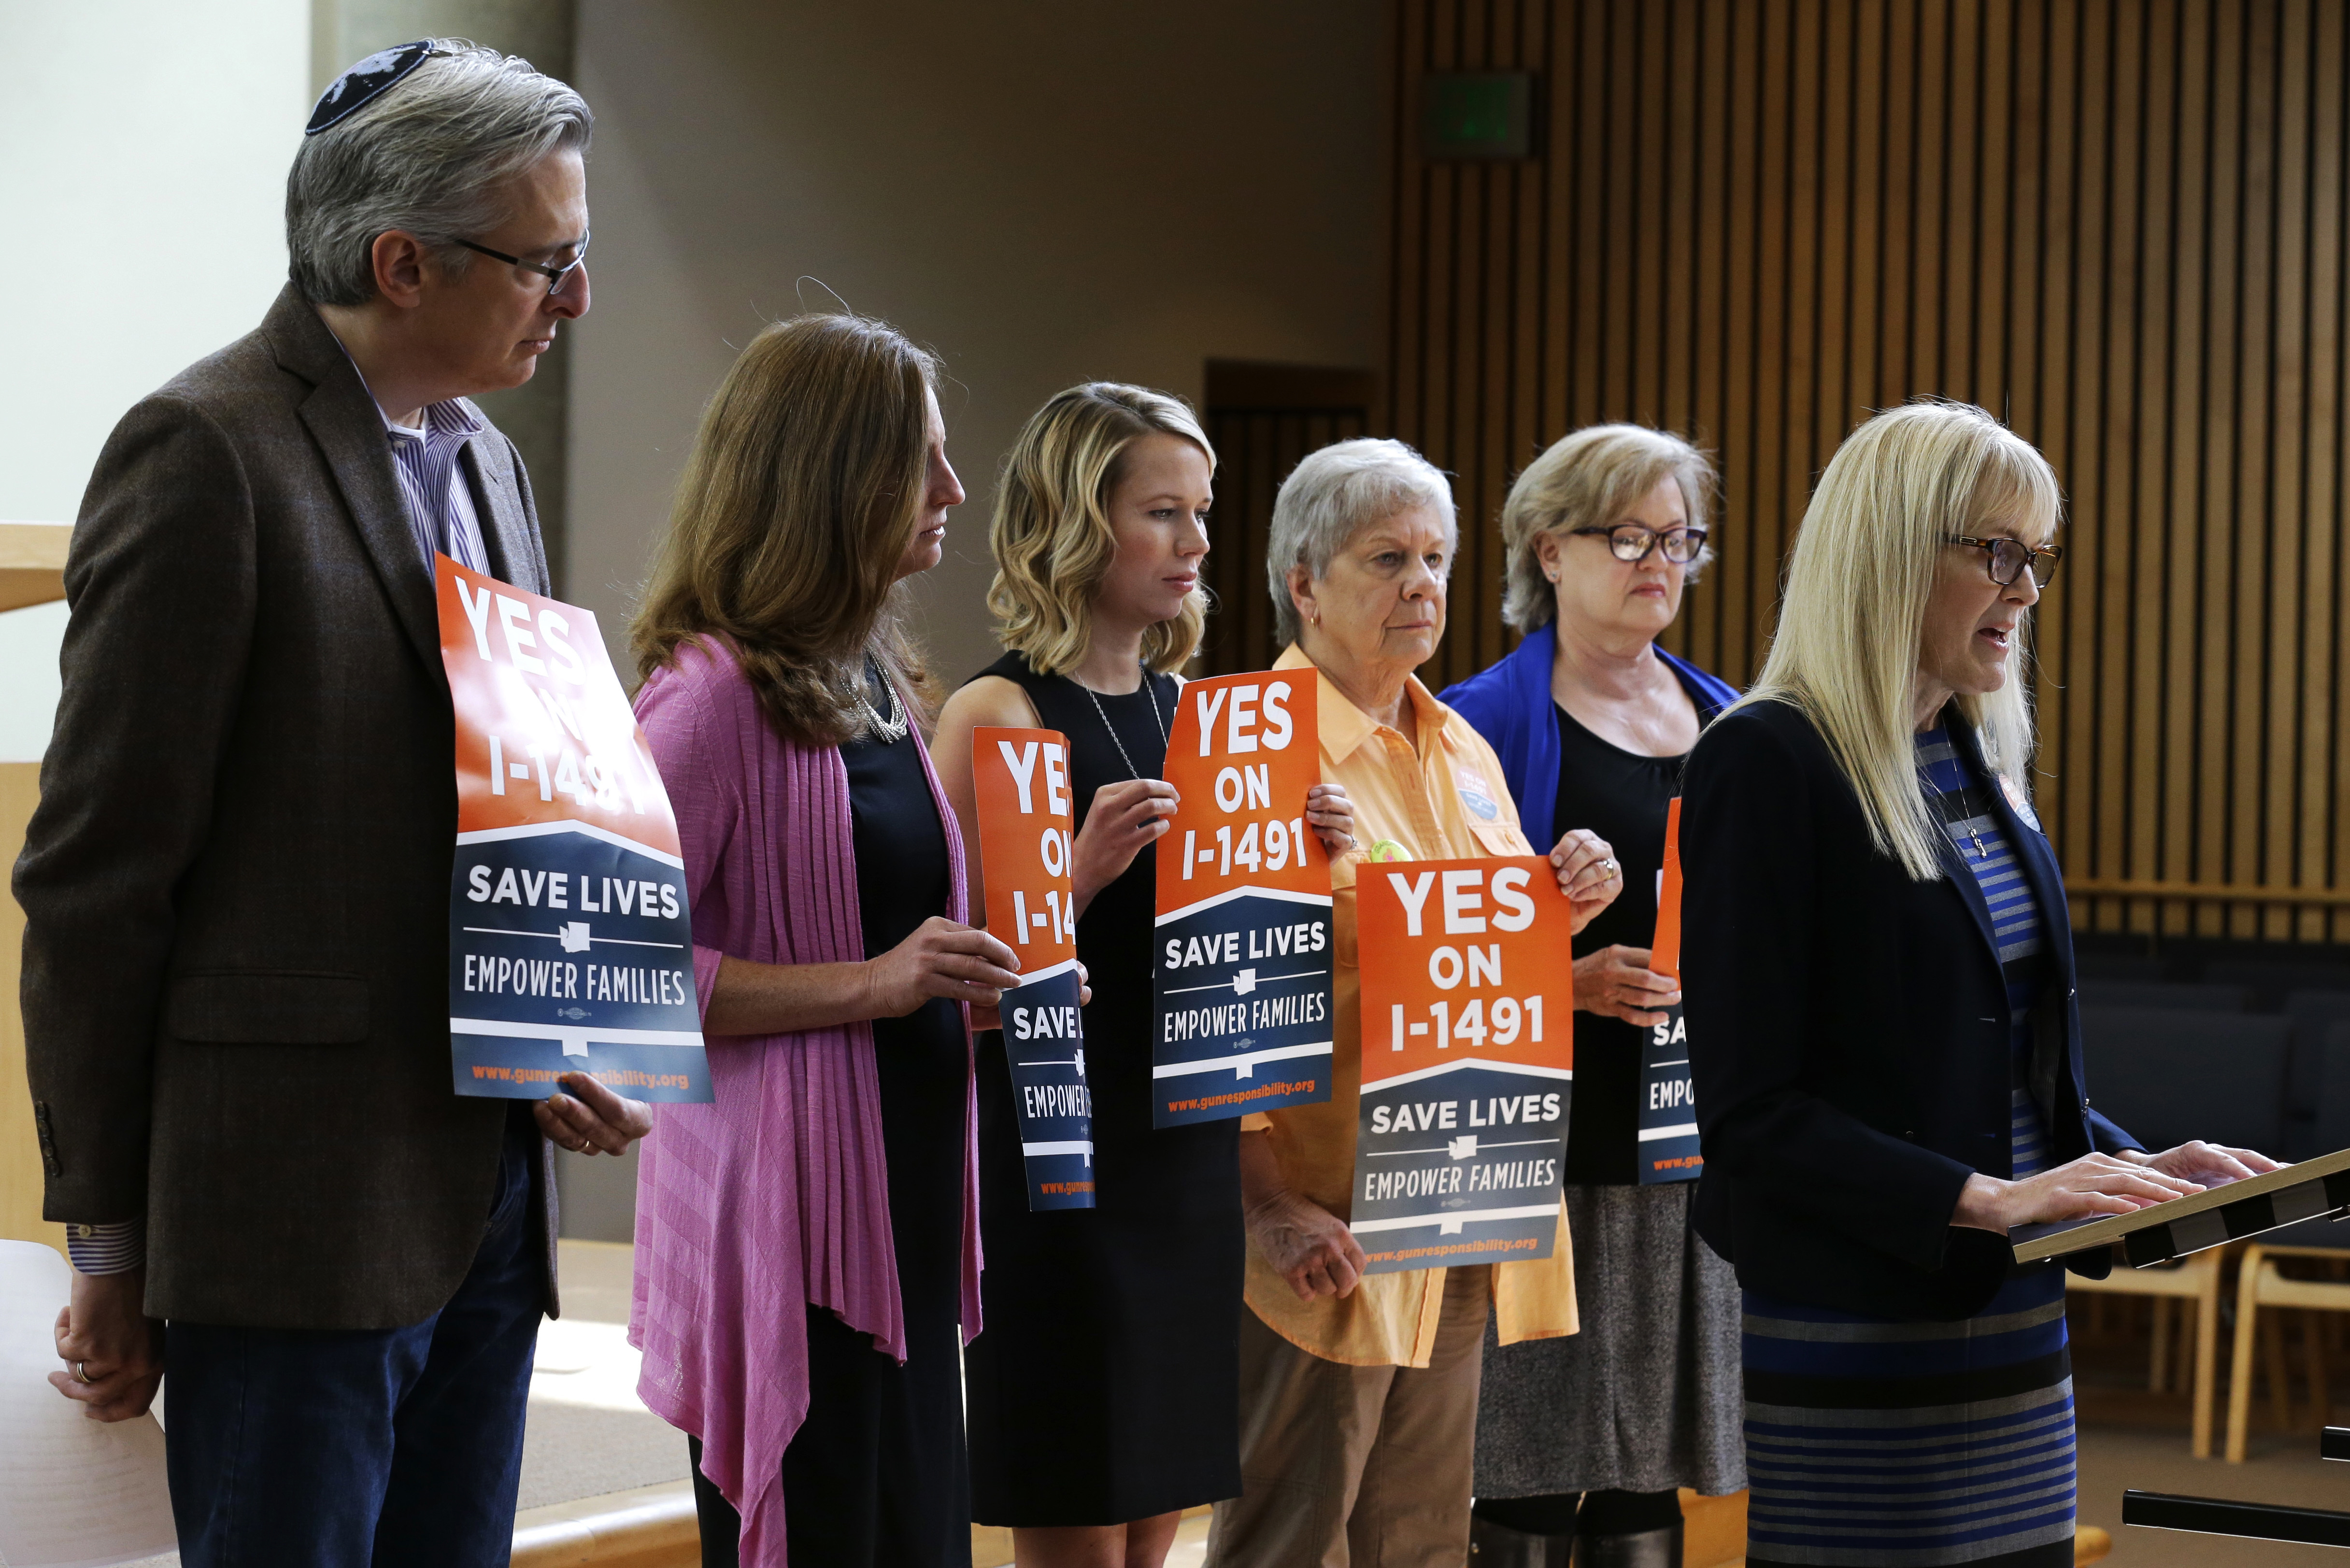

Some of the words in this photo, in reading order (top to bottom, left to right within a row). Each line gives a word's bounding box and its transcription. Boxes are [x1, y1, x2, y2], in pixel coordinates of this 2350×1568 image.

[455, 575, 585, 686] YES
[1197, 681, 1293, 757] YES
[489, 735, 645, 815] I-1491
[997, 741, 1070, 817] YE
[1215, 763, 1271, 813] ON
[1182, 817, 1307, 881] I-1491
[467, 865, 568, 909] SAVE
[581, 876, 680, 919] LIVES
[1387, 867, 1536, 936] YES
[1013, 890, 1076, 946] I-14
[1165, 932, 1239, 969] SAVE
[1249, 921, 1325, 960] LIVES
[1428, 944, 1502, 990] ON
[464, 954, 578, 999] EMPOWER
[587, 964, 686, 1006] FAMILIES
[1013, 1006, 1076, 1040] SAVE
[1164, 1003, 1246, 1043] EMPOWER
[1252, 992, 1325, 1030] FAMILIES
[1391, 995, 1543, 1052] I-1491
[1652, 1017, 1687, 1046] SA
[1024, 1085, 1086, 1118] EMPOWER
[1168, 1080, 1315, 1112] www.gunresponsibility.org
[1371, 1101, 1458, 1134] SAVE
[1469, 1093, 1561, 1128] LIVES
[1650, 1078, 1695, 1110] EMPO
[1365, 1167, 1463, 1201] EMPOWER
[1468, 1159, 1556, 1192] FAMILIES
